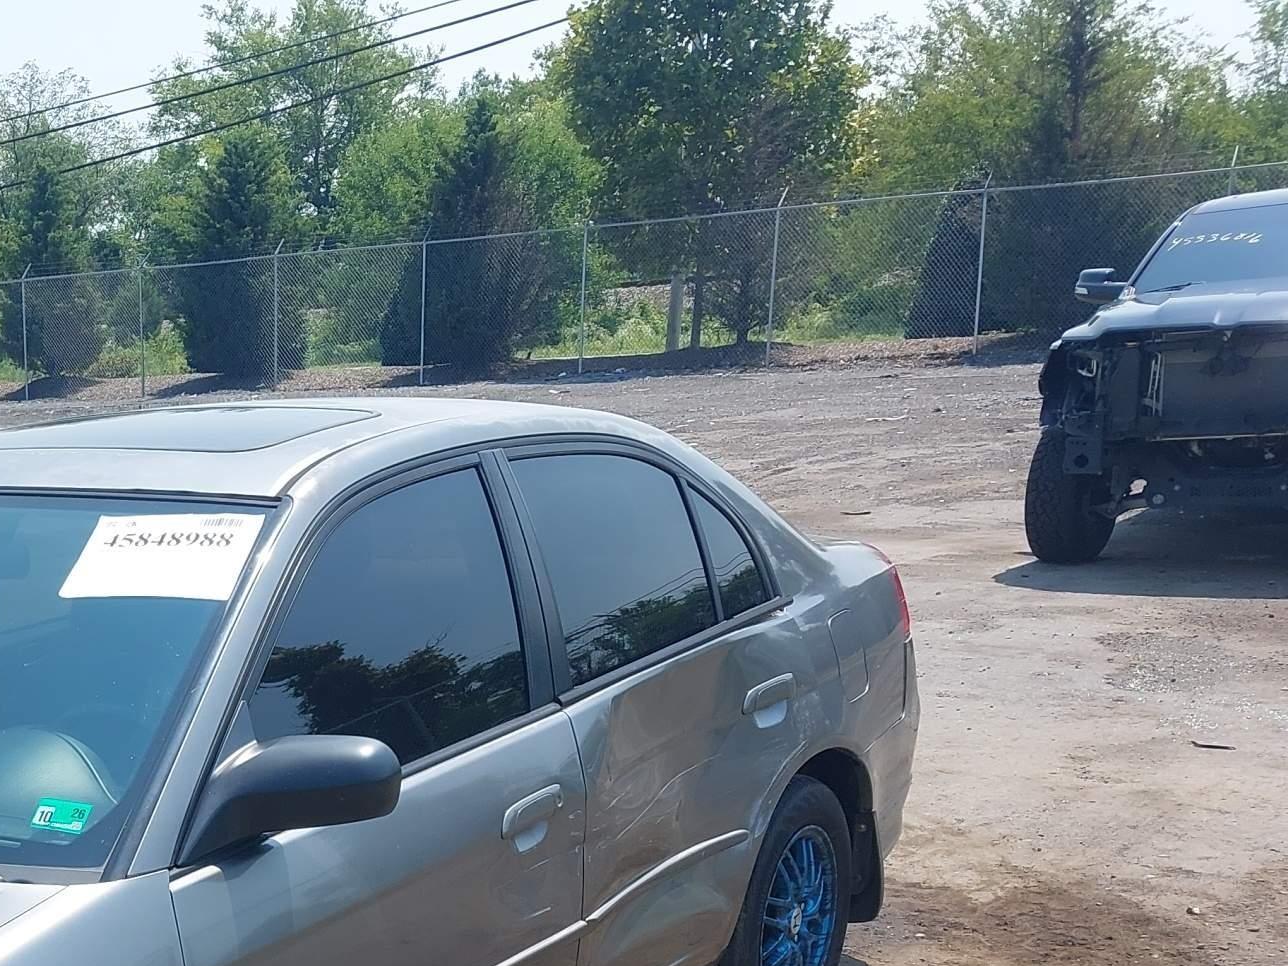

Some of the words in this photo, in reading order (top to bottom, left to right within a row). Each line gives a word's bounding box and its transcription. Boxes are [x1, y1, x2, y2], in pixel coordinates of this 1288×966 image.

[104, 532, 234, 548] 45848988
[38, 810, 53, 823] 10
[72, 808, 86, 819] 26
